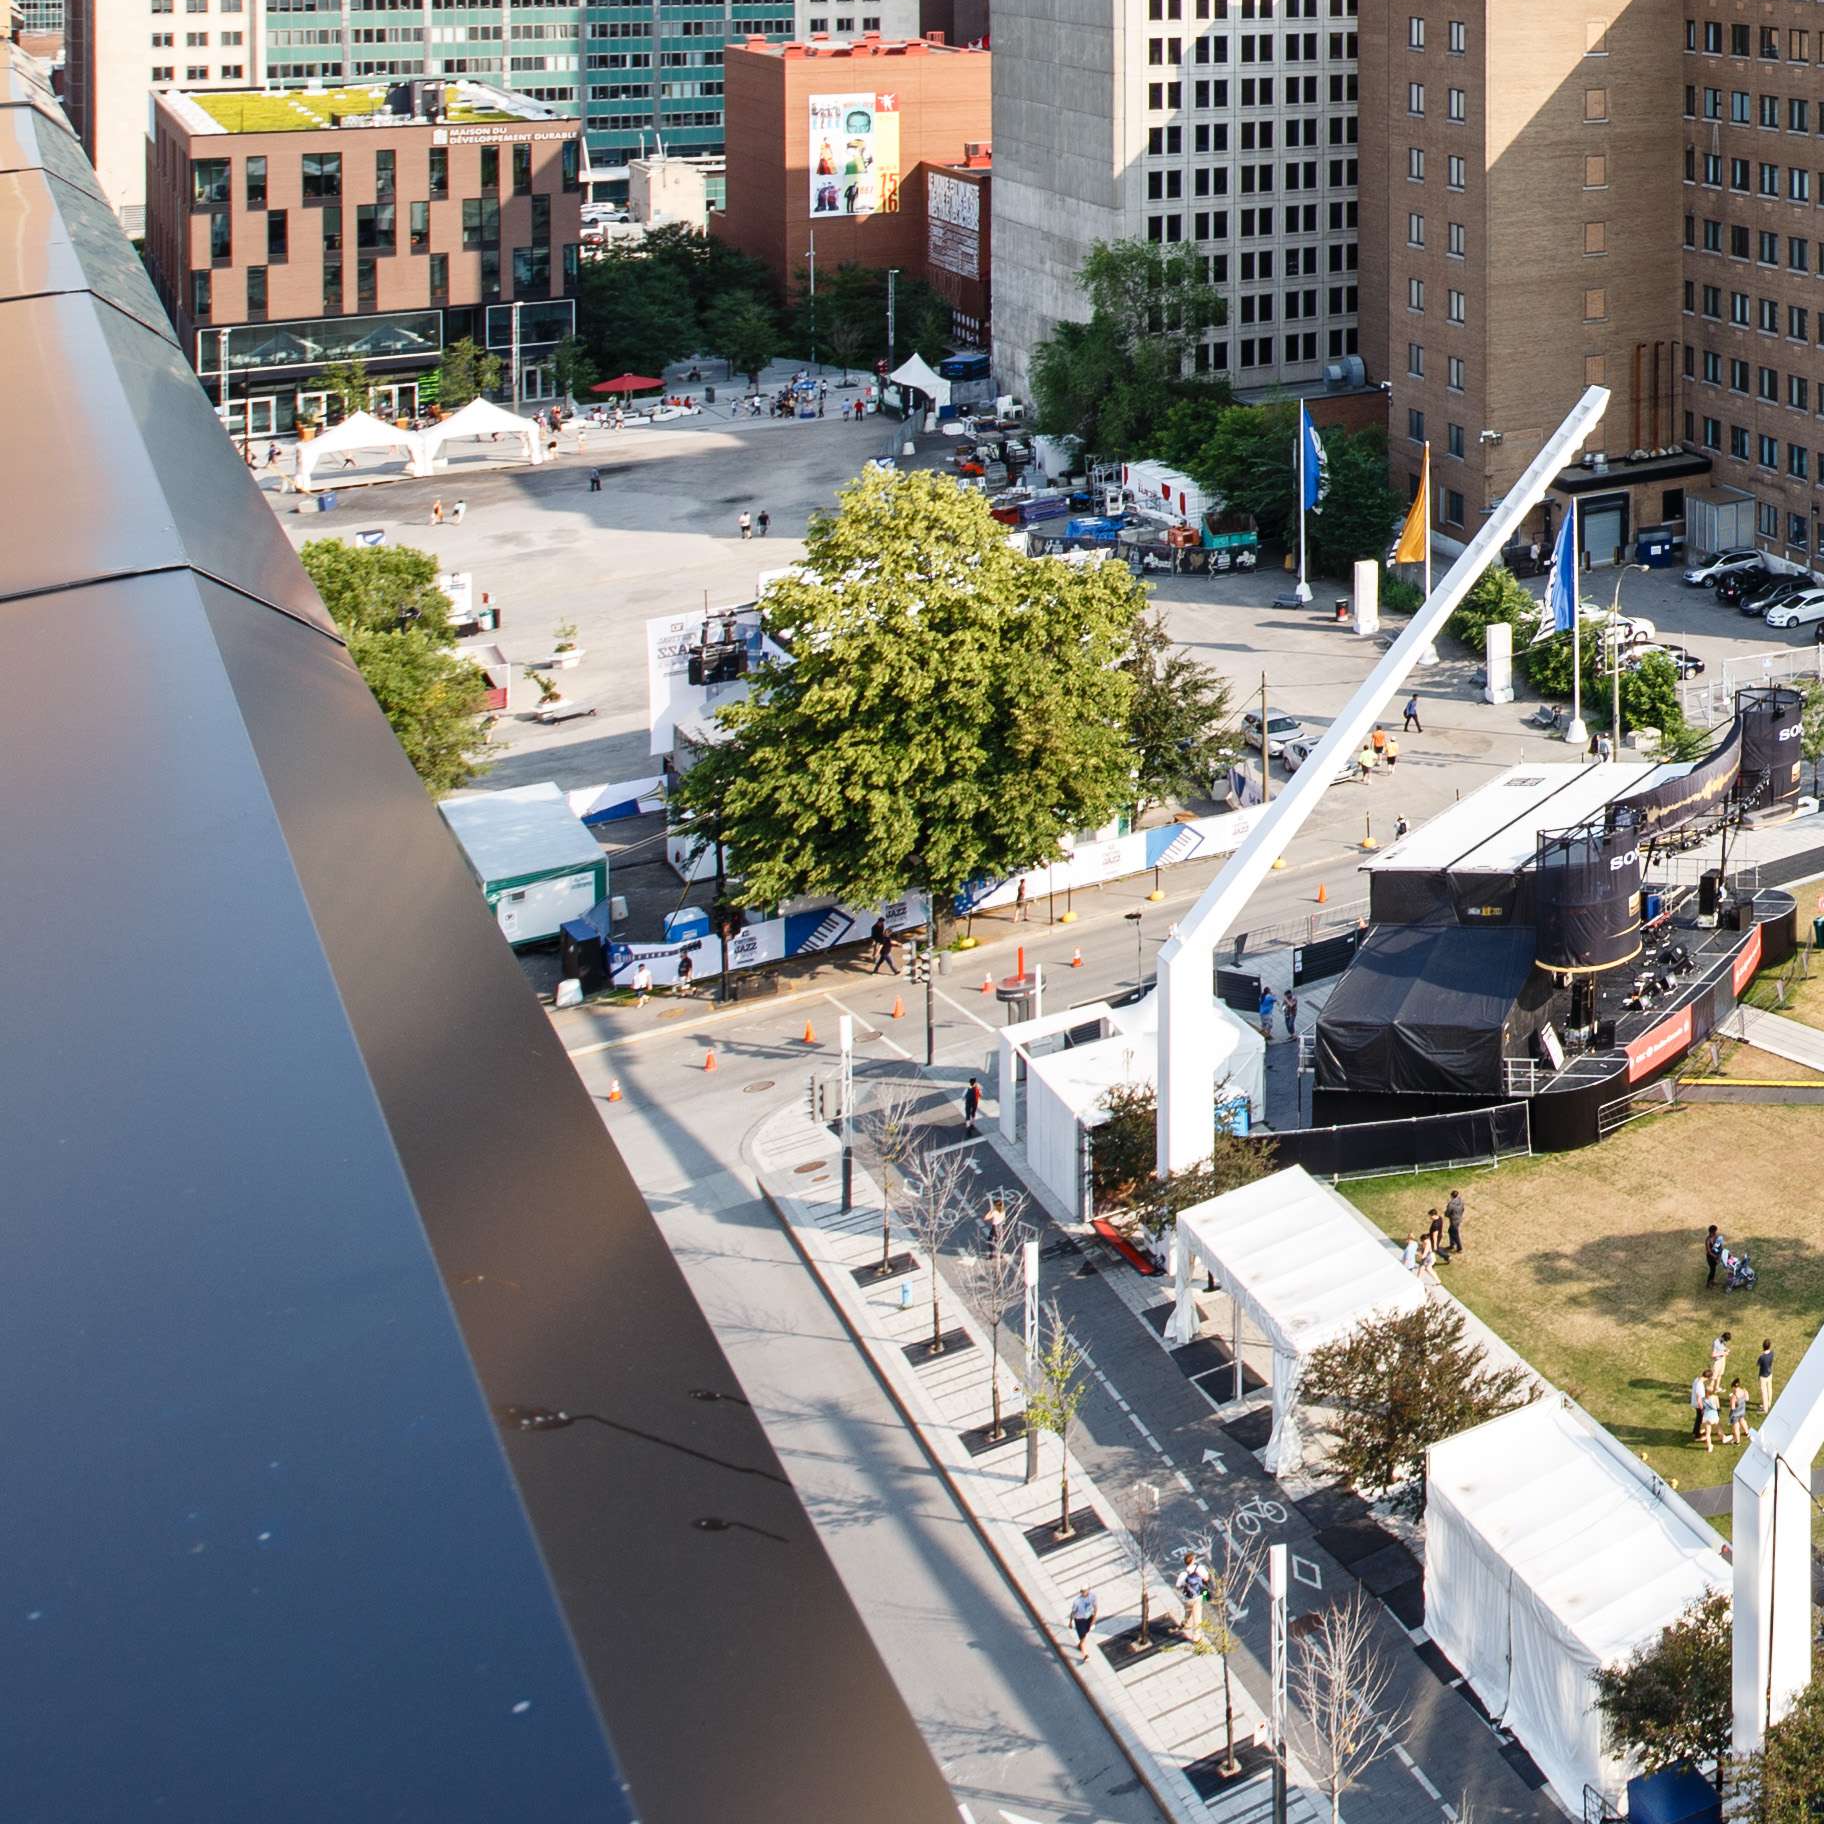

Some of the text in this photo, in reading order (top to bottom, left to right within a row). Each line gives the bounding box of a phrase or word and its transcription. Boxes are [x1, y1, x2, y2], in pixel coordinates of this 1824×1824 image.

[450, 128, 491, 136] MAISON
[450, 131, 577, 144] DÉVELOPPEMENT DURABLE
